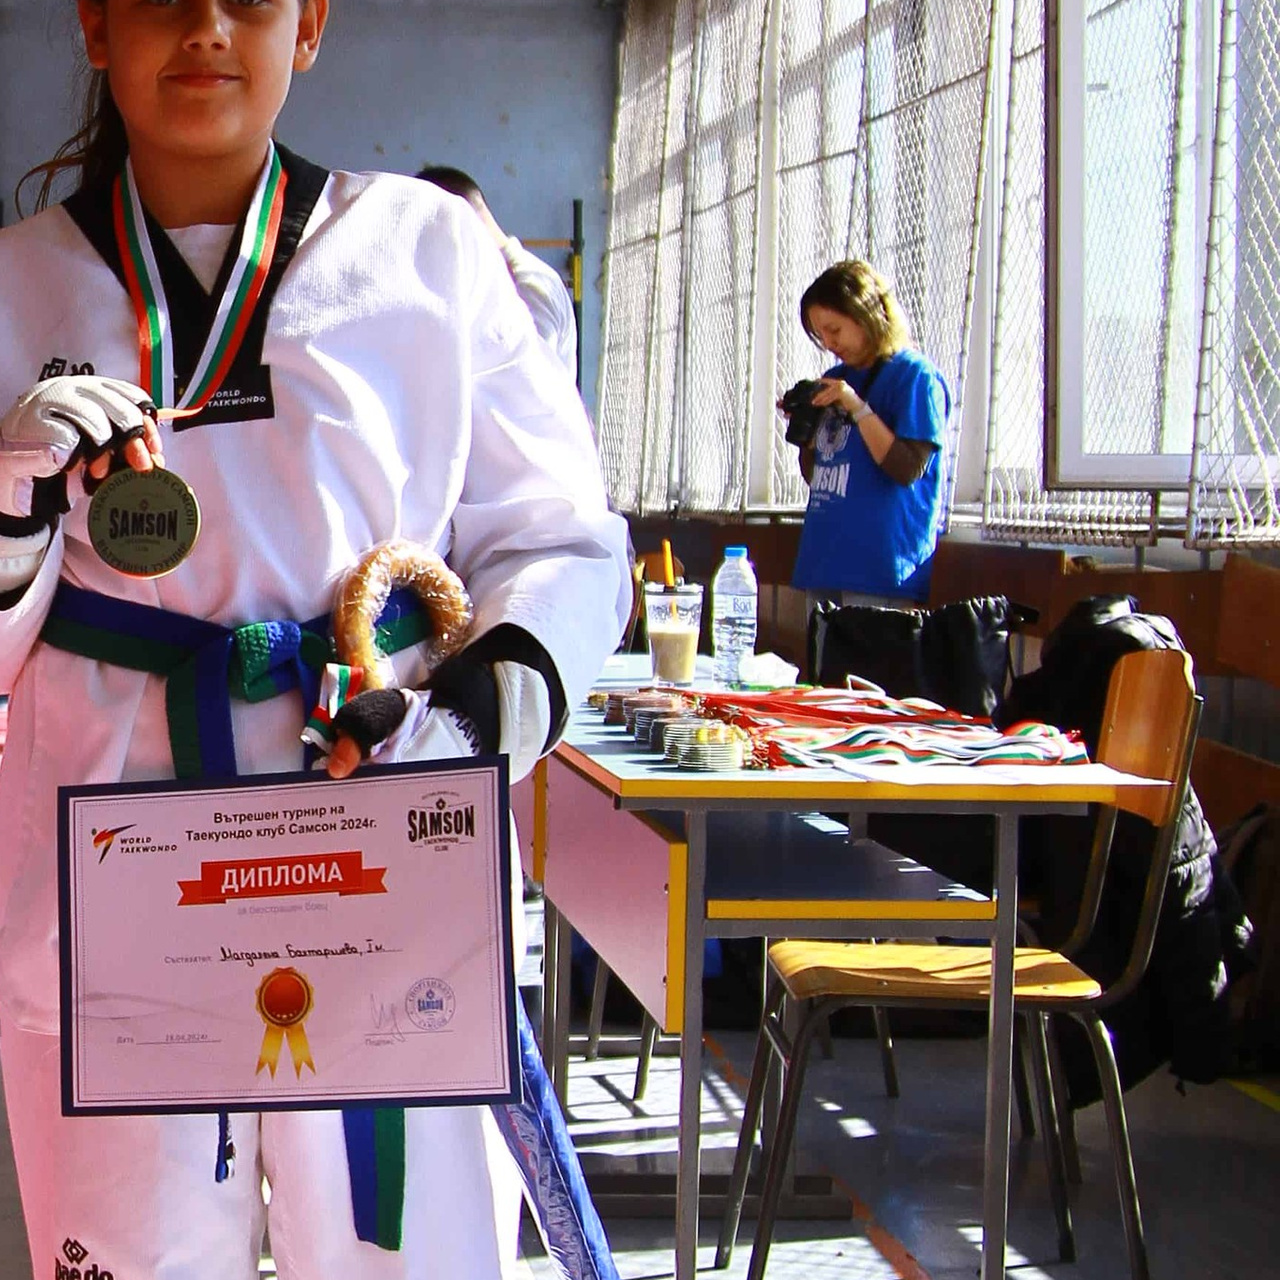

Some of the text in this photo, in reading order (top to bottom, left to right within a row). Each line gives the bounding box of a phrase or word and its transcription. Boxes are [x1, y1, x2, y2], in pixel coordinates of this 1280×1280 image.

[214, 389, 241, 398] ORLD
[108, 506, 178, 542] SAMSON
[214, 804, 345, 825] Вътрешен турнир на
[407, 805, 475, 843] SAMSON
[120, 836, 152, 845] WORLD
[185, 817, 377, 842] Таекуондо клуб Самсон 2024г.
[120, 844, 178, 854] TAEKWONDO
[221, 861, 344, 894] ДИПЛОМА
